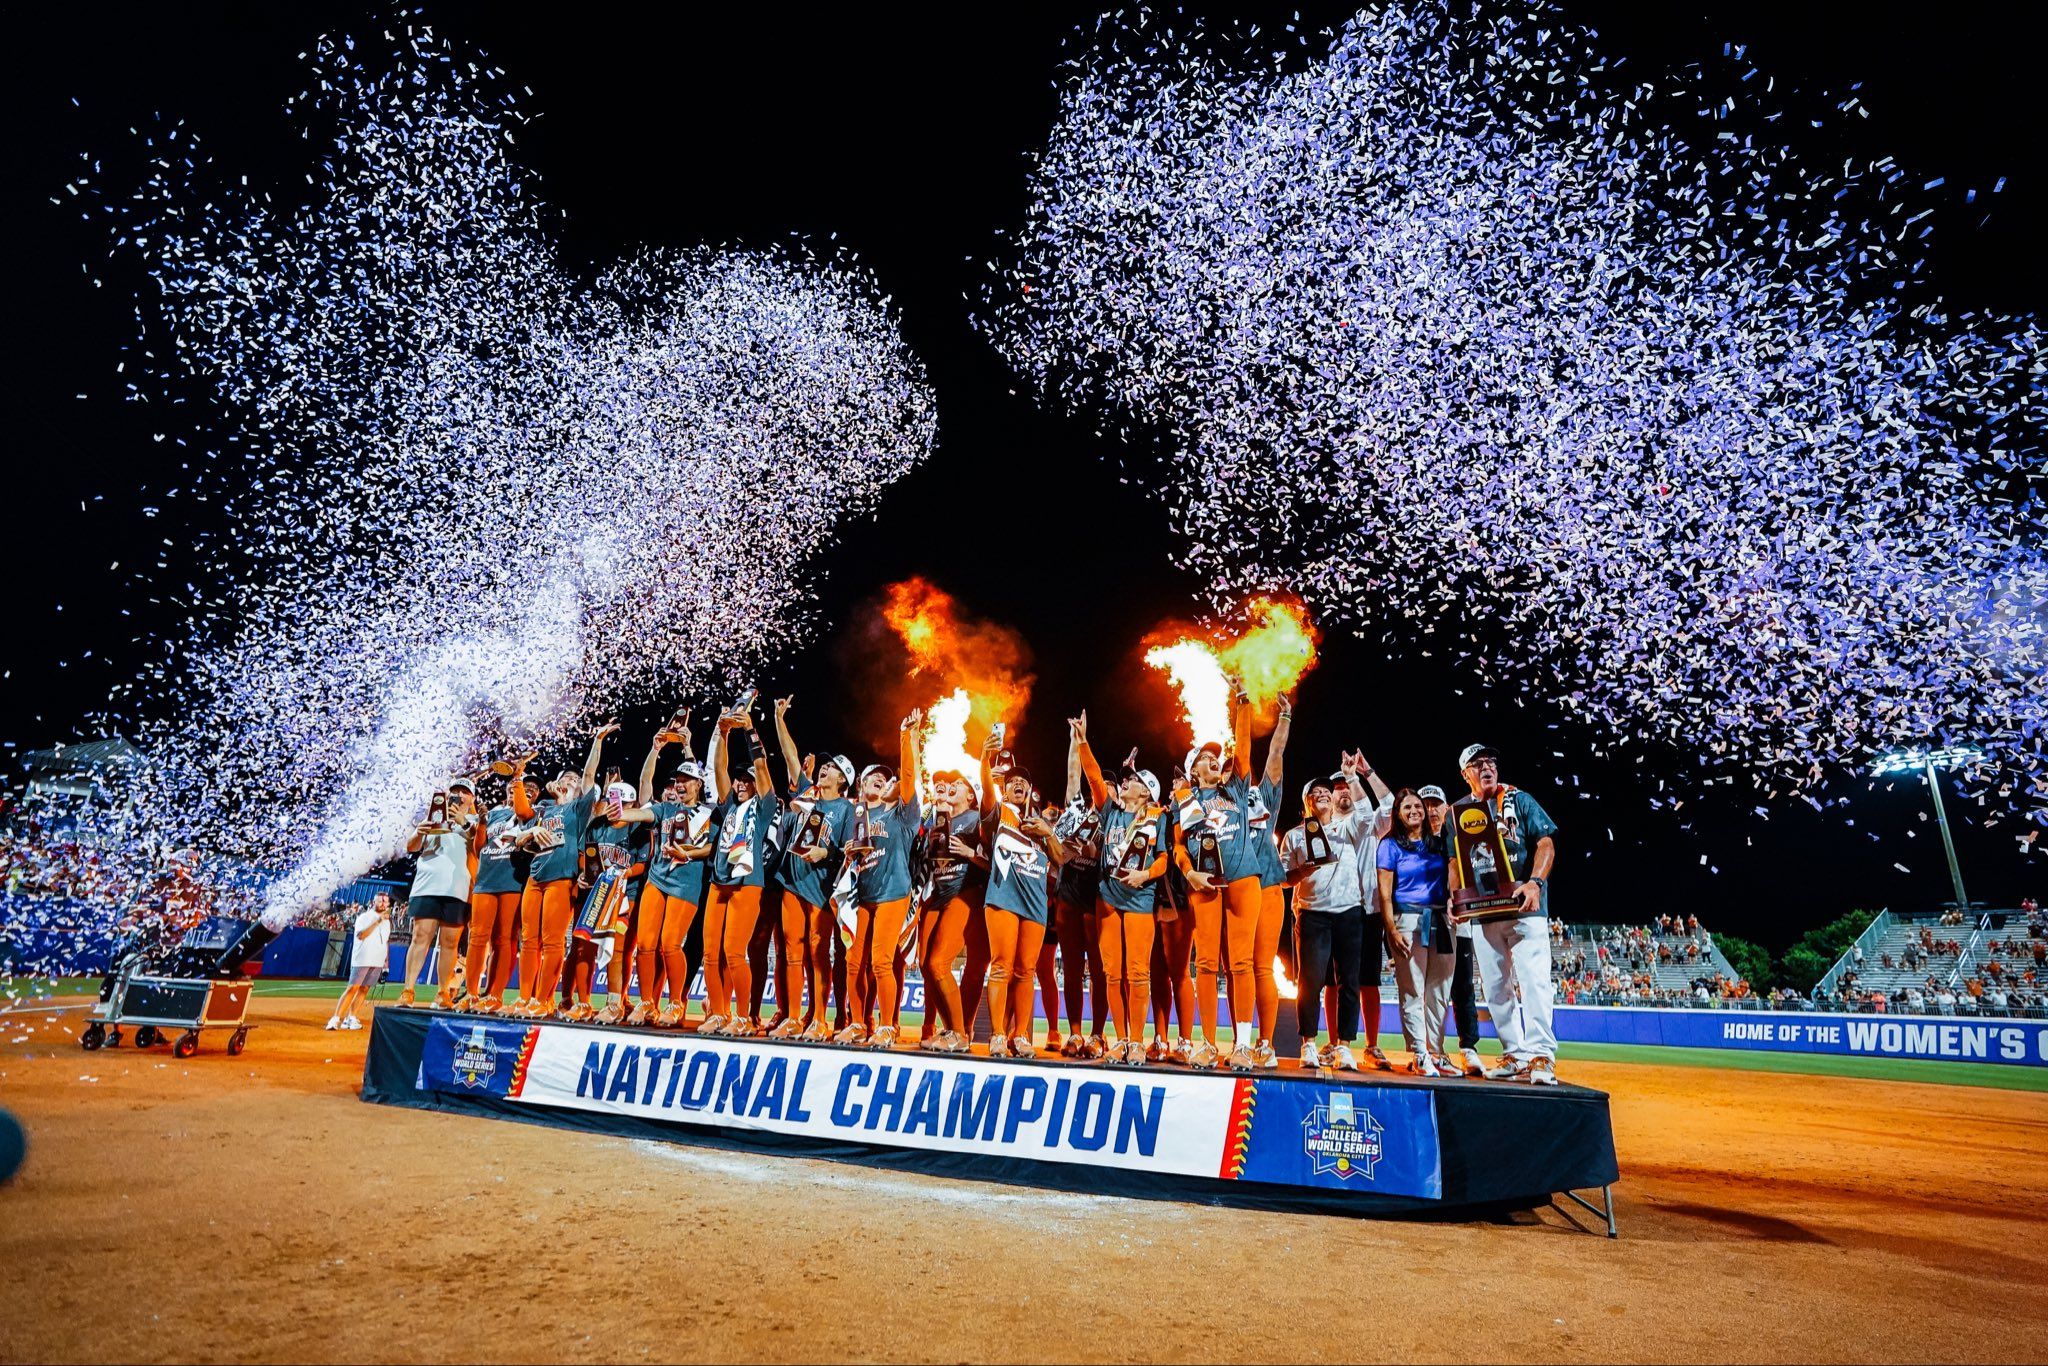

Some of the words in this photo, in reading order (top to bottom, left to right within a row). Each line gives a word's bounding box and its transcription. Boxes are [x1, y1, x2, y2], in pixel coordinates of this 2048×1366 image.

[1463, 819, 1487, 830] NCAA
[585, 881, 609, 928] CHAMPIONS
[1724, 1022, 1773, 1042] HOME
[1778, 1023, 1801, 1043] OF
[1805, 1025, 1841, 1044] THE
[1846, 1022, 2026, 1060] WOMEN'S
[455, 1059, 474, 1068] WORLD
[474, 1061, 494, 1070] SERIES
[463, 1052, 487, 1061] COLLEGE
[575, 1041, 812, 1123] NATIONAL
[830, 1062, 1166, 1157] CHAMPION
[1321, 1128, 1364, 1143] COLLEGE
[1308, 1138, 1342, 1153] WORLD
[1343, 1142, 1379, 1156] SERIES
